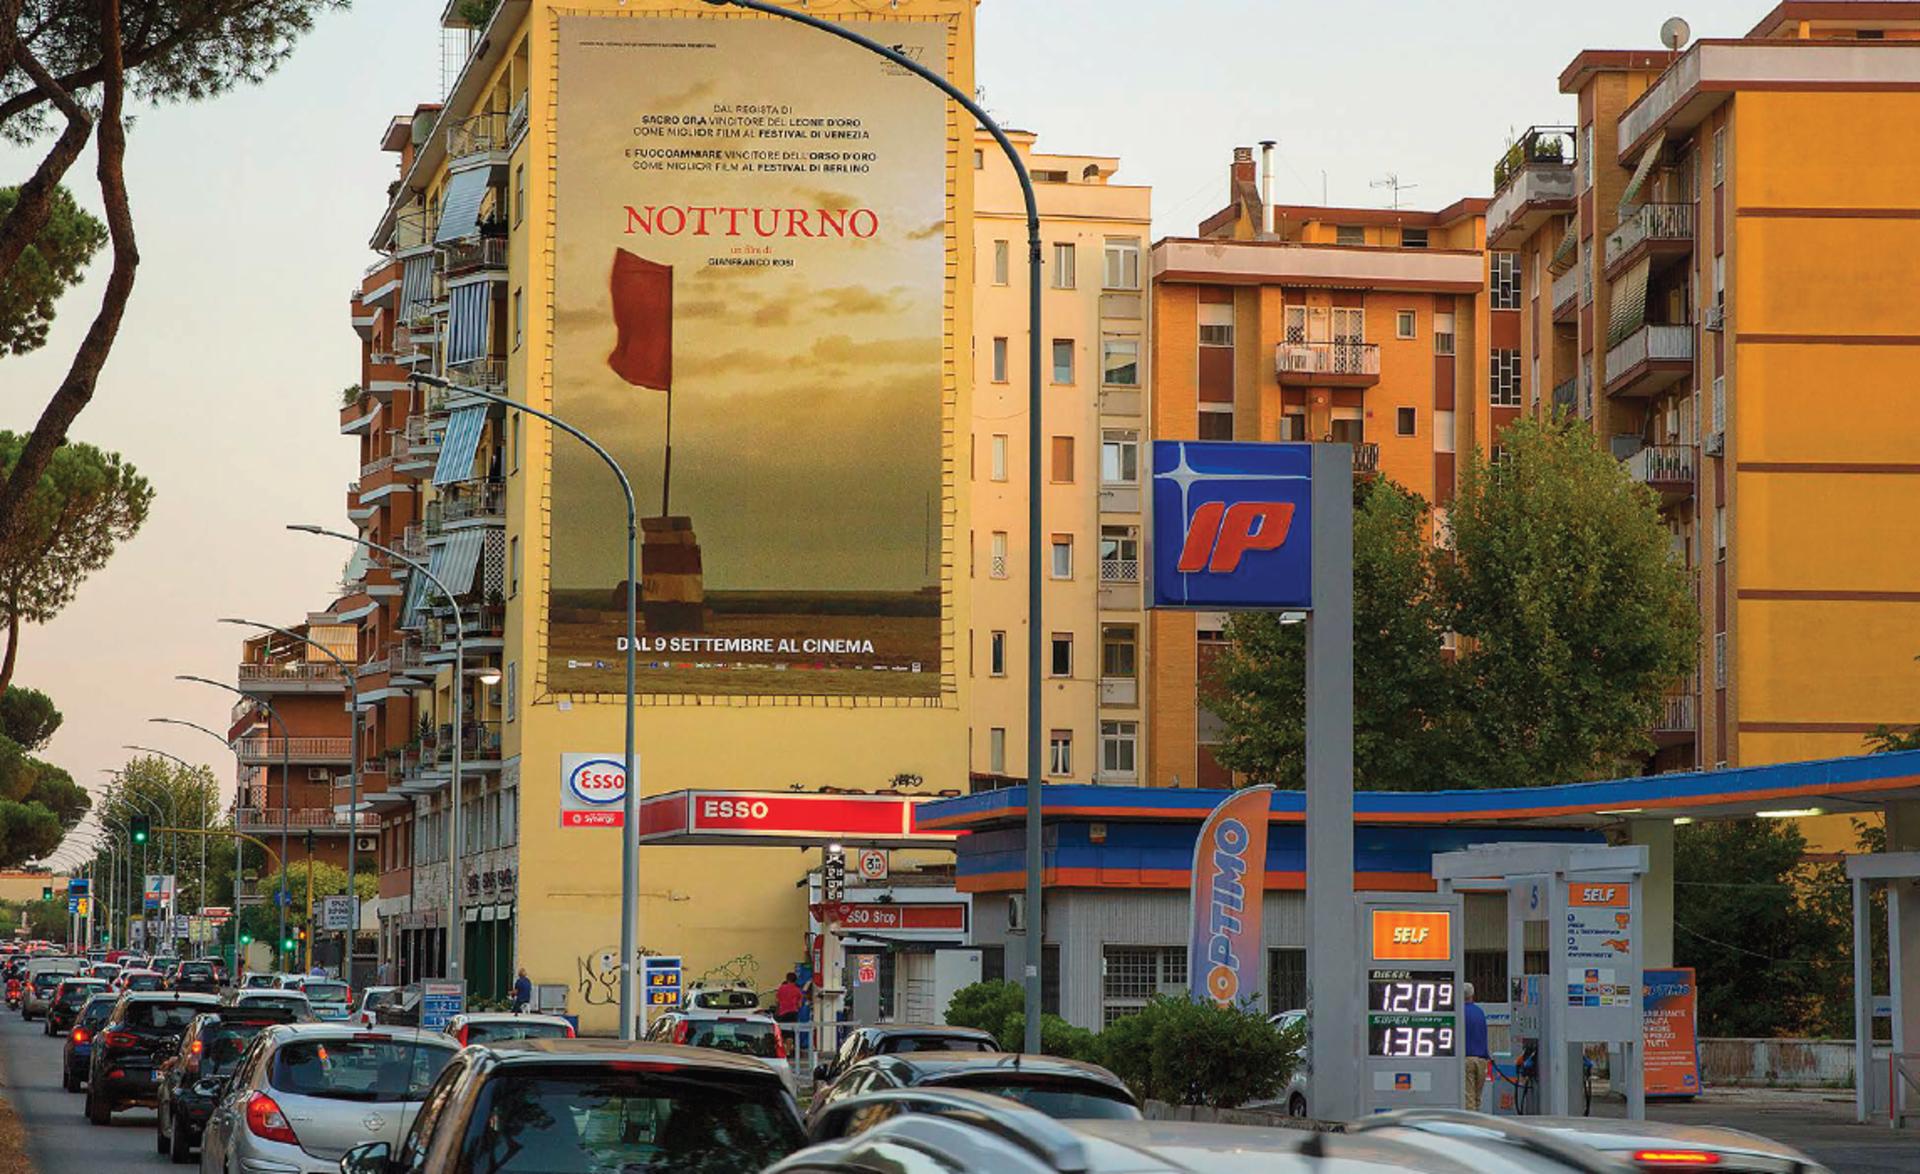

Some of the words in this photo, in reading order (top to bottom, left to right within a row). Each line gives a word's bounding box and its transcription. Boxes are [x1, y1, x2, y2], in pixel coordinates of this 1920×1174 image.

[714, 105, 733, 114] DAL
[736, 106, 779, 114] REGISTA
[782, 106, 793, 114] DI
[641, 115, 680, 125] SACRO
[708, 117, 765, 126] VINCITORE
[768, 118, 787, 126] DEL
[789, 118, 824, 127] LEONE
[827, 118, 861, 128] D'ORO
[633, 127, 664, 136] COME
[667, 128, 714, 137] MIGLIOR
[716, 128, 740, 138] FILM
[742, 129, 756, 138] AL
[759, 129, 808, 139] FESTIVAL
[810, 130, 821, 139] DI
[824, 130, 870, 140] VENEZIA
[624, 149, 631, 157] E
[725, 151, 781, 160] VINCITORE
[842, 152, 877, 161] D'ORO
[632, 161, 664, 170] COME
[666, 161, 713, 171] MIGLIOR
[715, 162, 739, 172] FILM
[742, 163, 755, 172] AL
[758, 163, 806, 173] FESTIVAL
[809, 164, 821, 173] DI
[823, 164, 870, 173] BERLINO
[623, 205, 879, 238] NOTTURNO
[708, 258, 771, 267] GIANFRANCO
[772, 258, 794, 267] ROSI
[1177, 500, 1295, 573] IP
[655, 637, 667, 651] 9
[670, 637, 773, 652] SETTEMBRE
[777, 638, 800, 653] AL
[803, 639, 874, 653] CINEMA
[704, 801, 769, 819] ESSO
[1530, 886, 1538, 910] 5
[1583, 888, 1616, 902] SELF
[847, 910, 870, 922] SSO
[873, 909, 896, 924] Shop
[1207, 818, 1250, 1001] OPTIMO
[1393, 926, 1430, 944] SELF
[1373, 970, 1412, 979] DIESEL
[1373, 1016, 1409, 1024] SUPER
